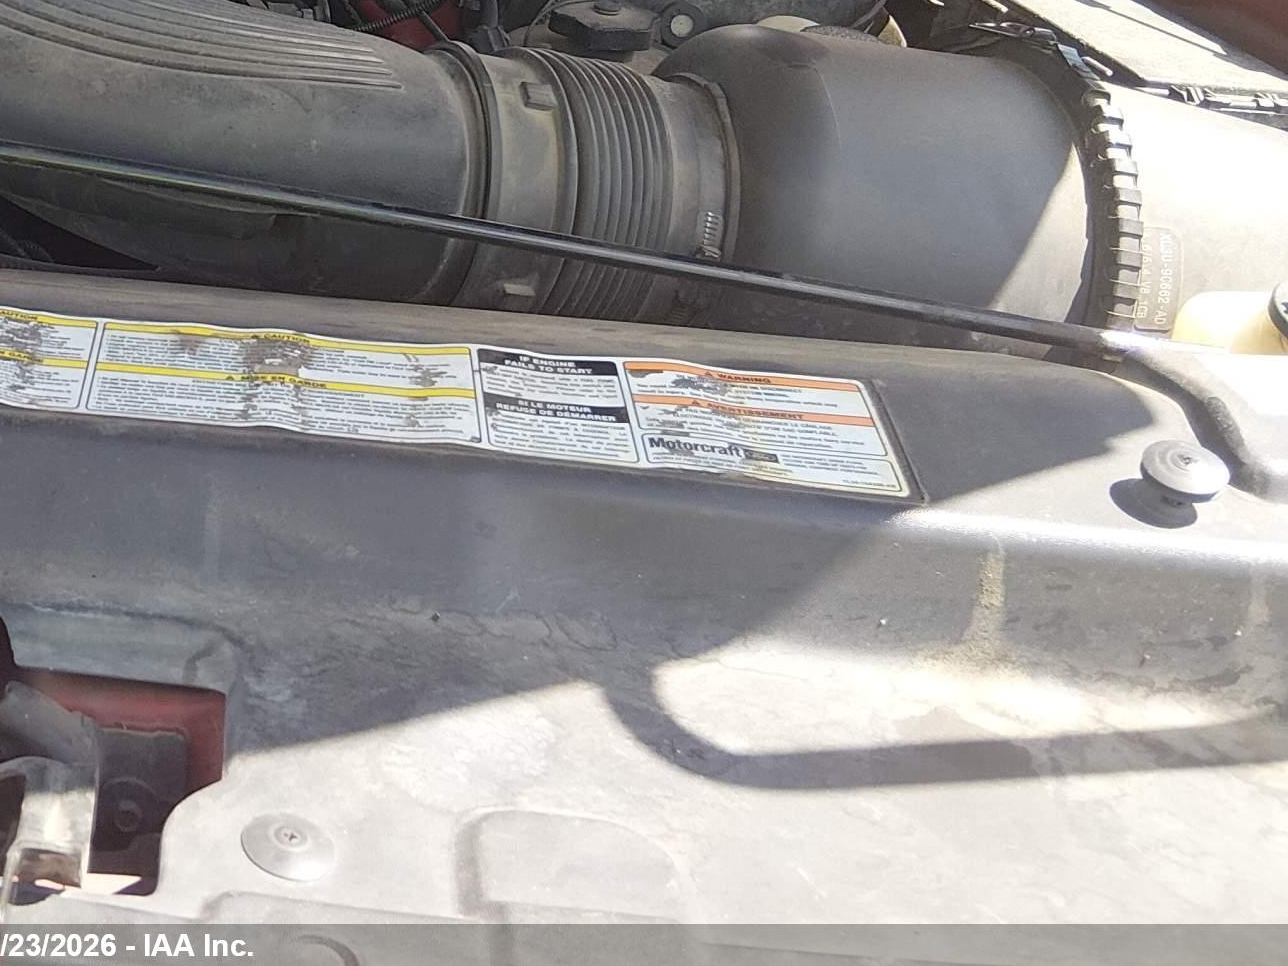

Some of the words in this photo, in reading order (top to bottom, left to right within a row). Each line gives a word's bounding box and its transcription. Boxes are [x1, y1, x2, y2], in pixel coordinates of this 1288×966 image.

[263, 333, 310, 345] CAUTION
[504, 359, 535, 370] FAILS
[557, 366, 593, 374] START
[533, 358, 576, 367] ENGINE
[718, 374, 771, 384] WARNING
[496, 402, 537, 414] REFUSE
[546, 403, 592, 413] MOTEUR
[648, 437, 743, 458] Motorcraft
